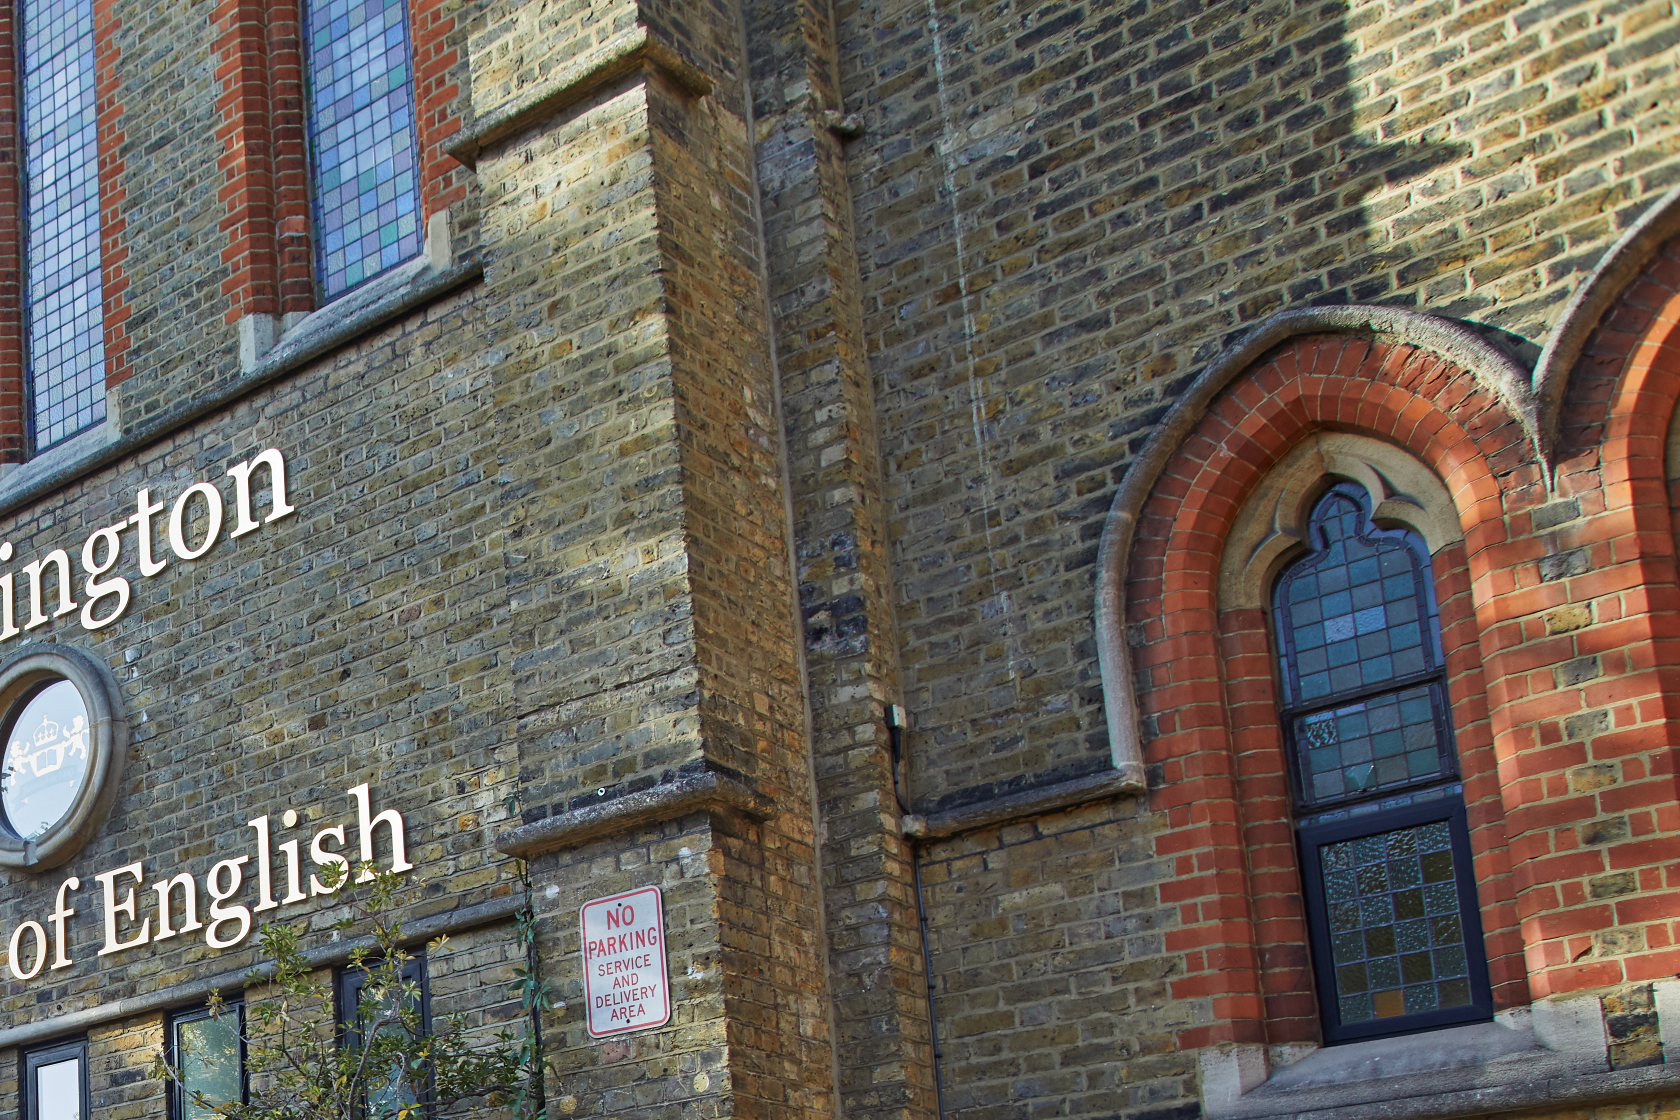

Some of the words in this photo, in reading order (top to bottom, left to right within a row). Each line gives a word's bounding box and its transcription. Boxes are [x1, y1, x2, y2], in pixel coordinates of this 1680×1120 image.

[8, 877, 82, 980] of
[96, 783, 414, 955] English
[606, 905, 635, 930] NO
[588, 927, 657, 960] PARKING
[598, 954, 652, 977] SERVICE
[612, 972, 639, 990] AND
[596, 984, 657, 1009] DELIVERY
[610, 1003, 646, 1022] AREA
